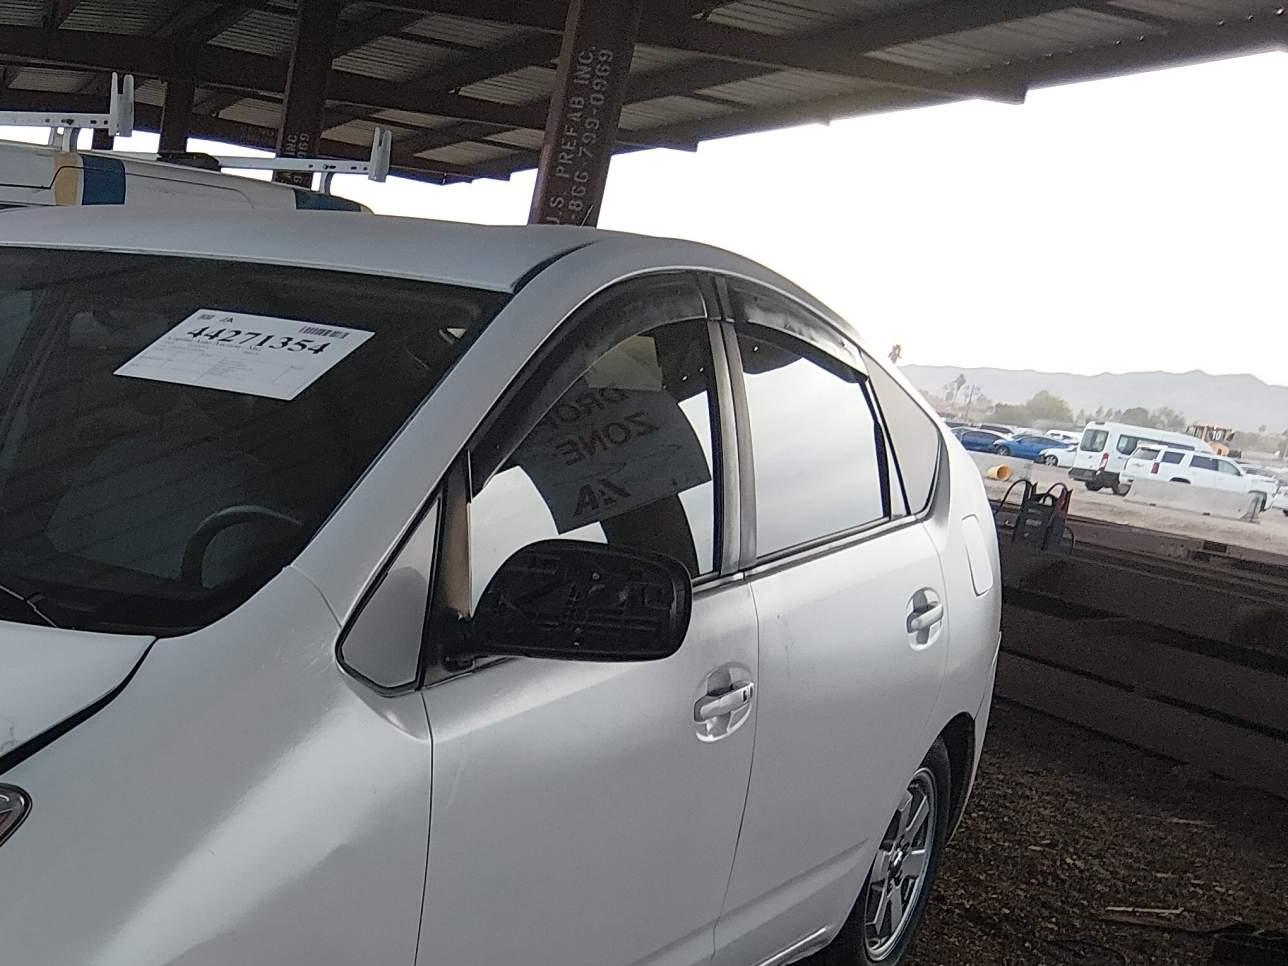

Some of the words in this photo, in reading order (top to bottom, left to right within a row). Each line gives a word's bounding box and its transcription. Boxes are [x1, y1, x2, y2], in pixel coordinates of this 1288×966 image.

[556, 97, 585, 179] PREFAB
[573, 46, 596, 85] INC.
[187, 326, 331, 355] 44271354
